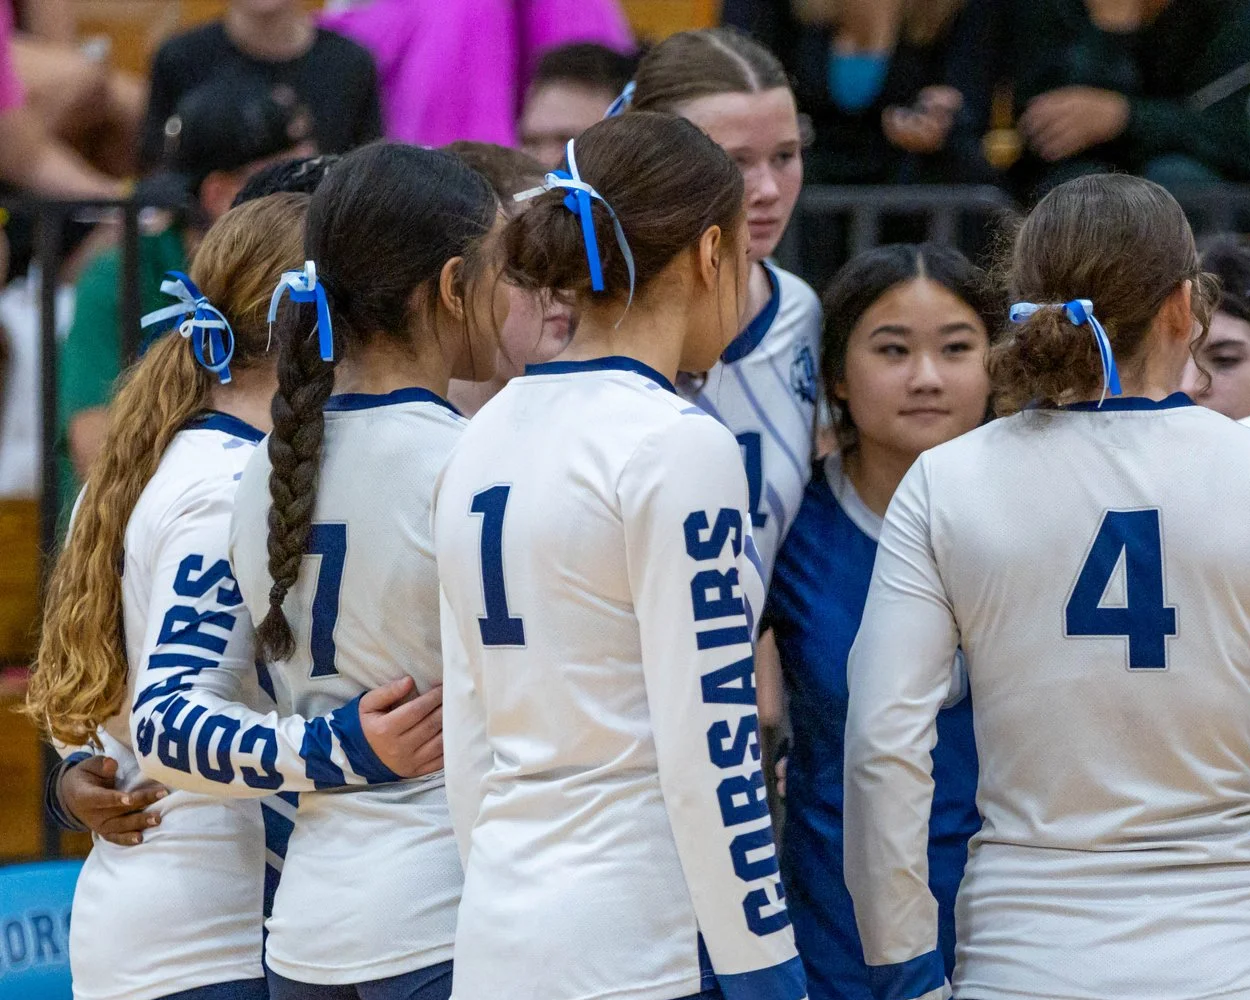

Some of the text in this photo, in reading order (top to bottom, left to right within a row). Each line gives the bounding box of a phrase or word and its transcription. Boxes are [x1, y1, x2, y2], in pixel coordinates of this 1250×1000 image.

[302, 521, 348, 680] 7
[468, 481, 527, 648] 1
[1063, 506, 1178, 672] 4
[683, 506, 792, 938] CORSAIRS
